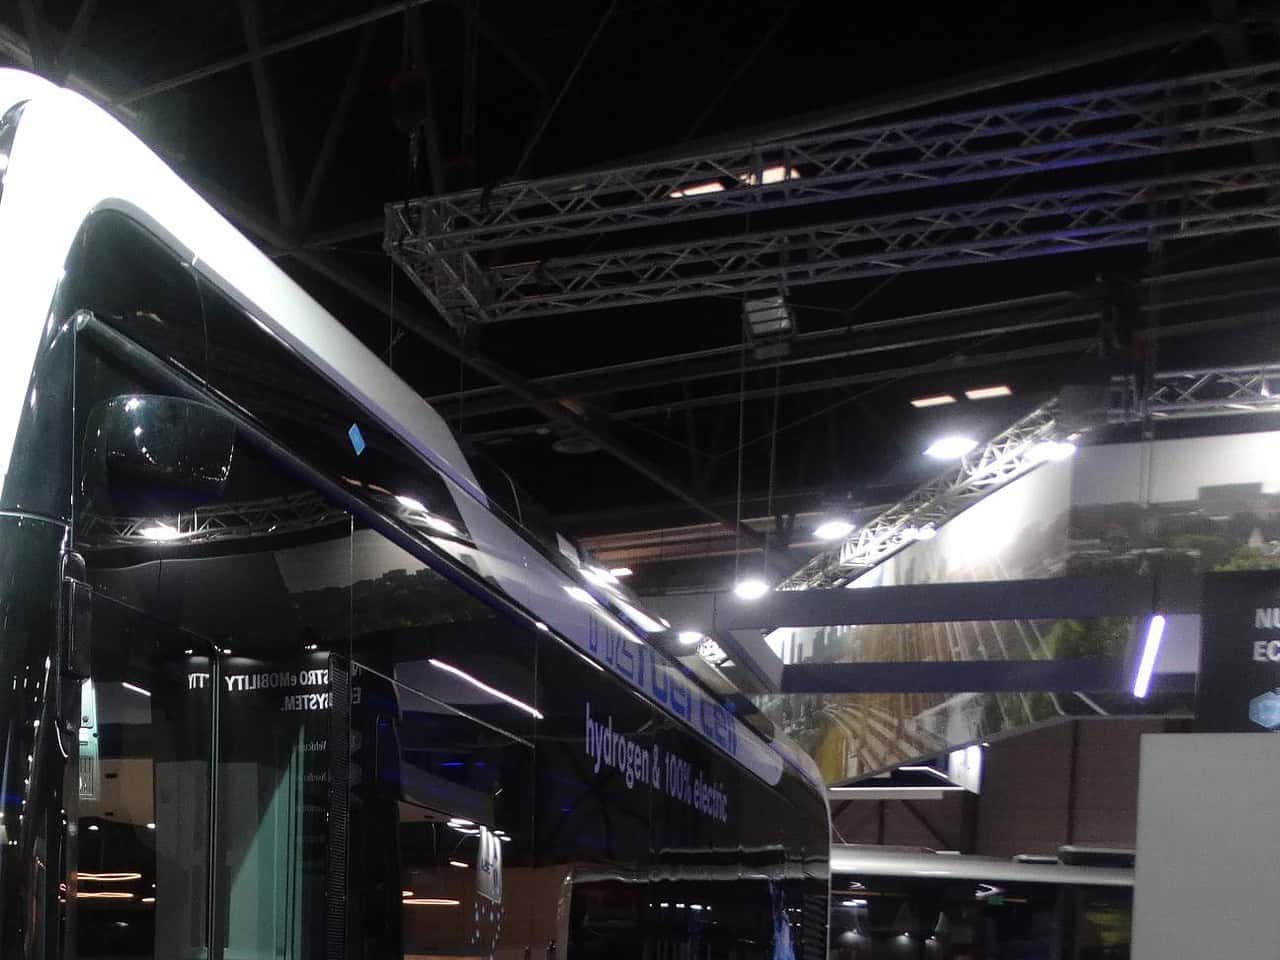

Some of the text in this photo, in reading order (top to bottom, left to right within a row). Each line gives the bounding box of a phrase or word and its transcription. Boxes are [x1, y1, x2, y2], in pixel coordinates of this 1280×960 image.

[586, 702, 649, 789] hydrogen
[652, 744, 660, 789] &
[665, 752, 691, 804] 100%
[693, 770, 728, 822] electric
